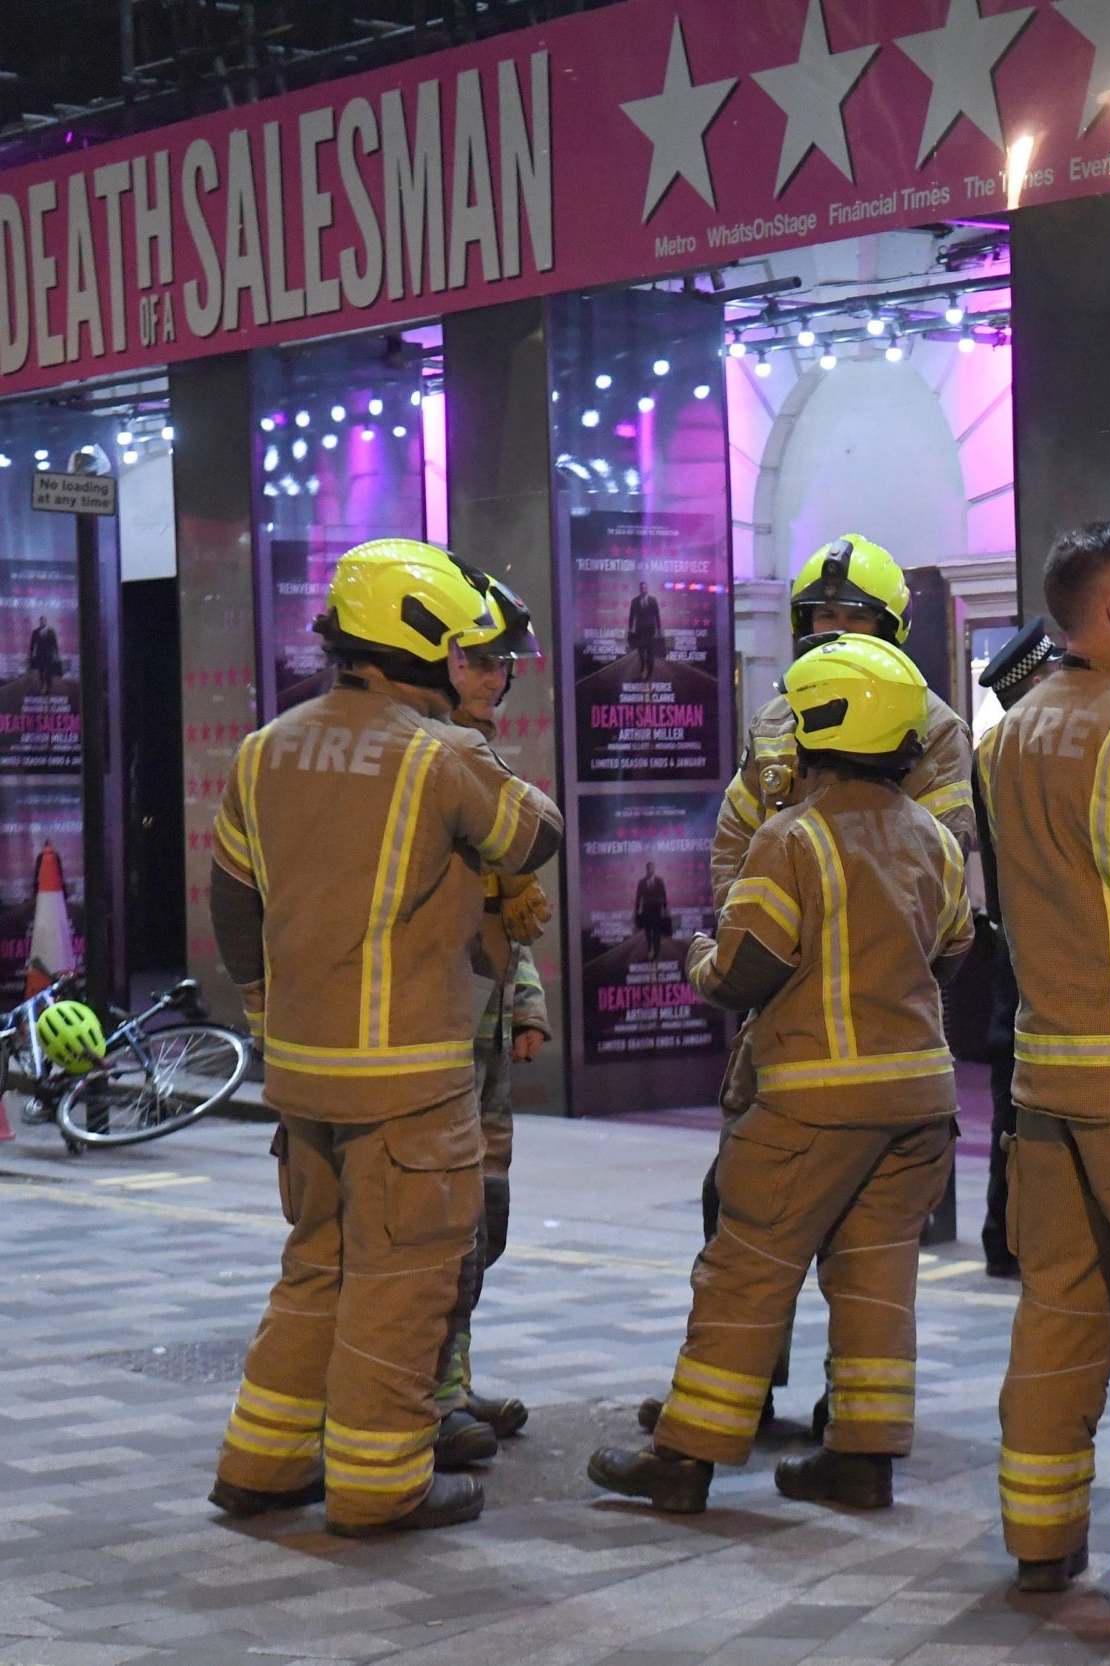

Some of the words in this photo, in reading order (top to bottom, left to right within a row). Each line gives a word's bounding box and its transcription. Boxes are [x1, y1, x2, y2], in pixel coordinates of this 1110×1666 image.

[0, 149, 173, 377] DEATH
[140, 294, 161, 348] OF
[161, 291, 176, 343] A
[182, 50, 554, 338] SALESMAN
[654, 235, 696, 259] Metro
[707, 213, 817, 249] WhatsOnStage
[828, 192, 896, 226] Financial
[900, 181, 950, 210] Times
[964, 174, 995, 200] The
[999, 167, 1054, 193] Tmes
[38, 494, 50, 504] at
[54, 497, 76, 508] any
[81, 496, 109, 508] time
[40, 478, 58, 490] No
[62, 481, 108, 496] loading
[591, 704, 634, 728] DEATH
[635, 704, 704, 728] SALESMAN
[998, 705, 1099, 760] FIRE
[271, 725, 392, 776] FIRE
